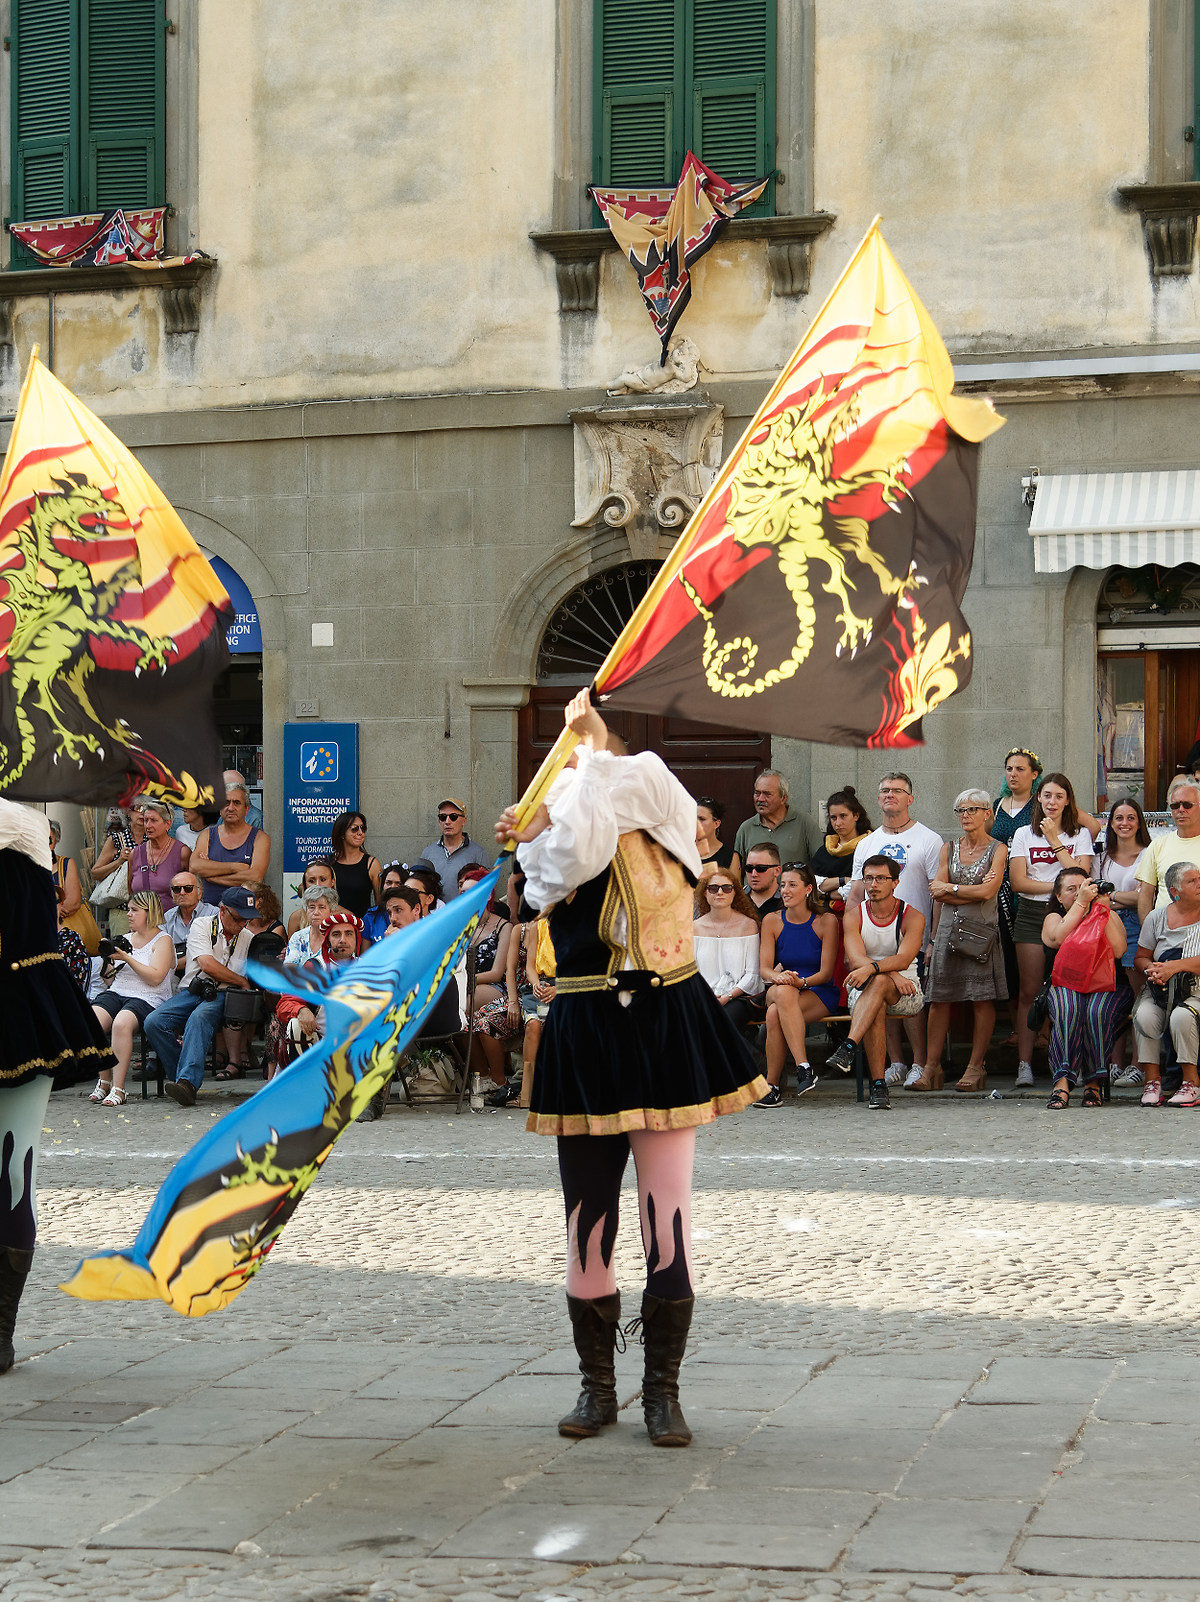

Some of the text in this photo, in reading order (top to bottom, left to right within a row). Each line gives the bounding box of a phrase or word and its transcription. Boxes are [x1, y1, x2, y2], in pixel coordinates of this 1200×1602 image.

[234, 614, 257, 623] FFICE
[288, 798, 350, 806] INFORMAZIONI E
[292, 806, 347, 815] PRENOTAZIONI
[298, 815, 337, 823] TURISTICH
[295, 837, 321, 845] TOURIST
